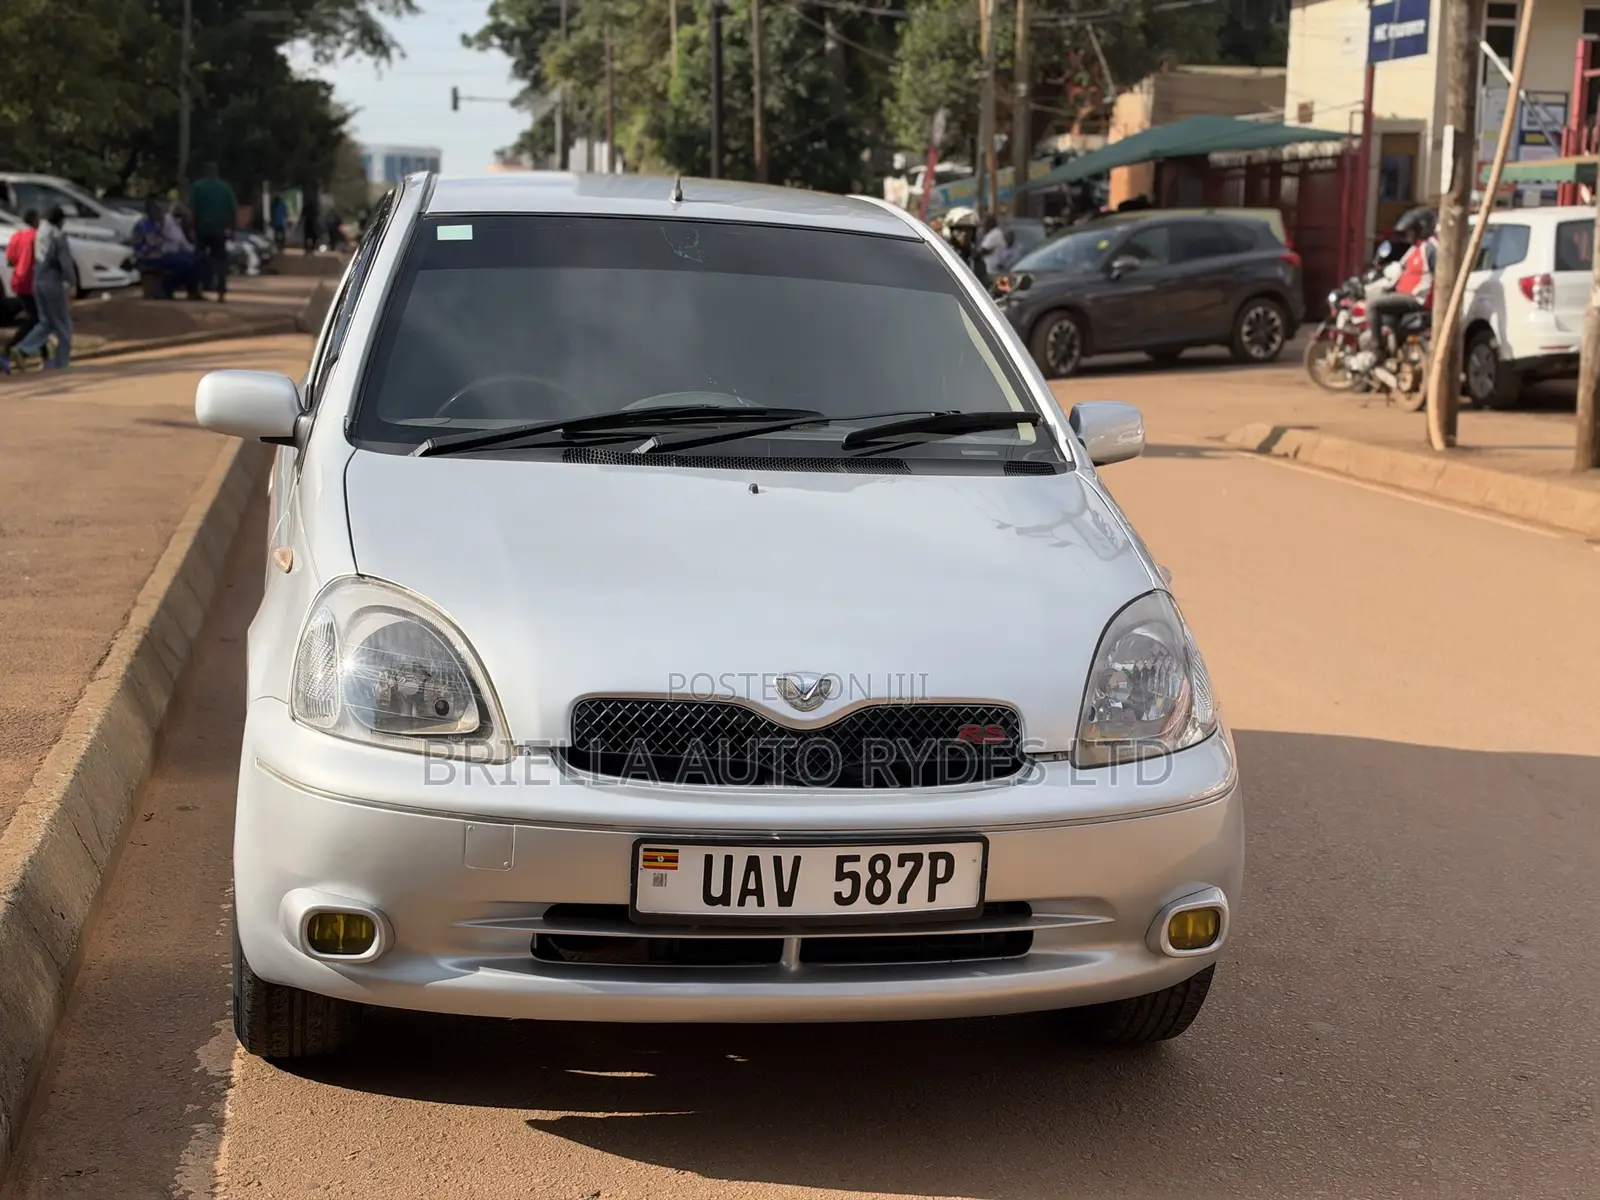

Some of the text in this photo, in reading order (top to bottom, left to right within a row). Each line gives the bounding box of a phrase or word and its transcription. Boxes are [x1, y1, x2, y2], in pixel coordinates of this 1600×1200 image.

[956, 724, 1006, 744] RS
[702, 851, 956, 907] UAV 587P
